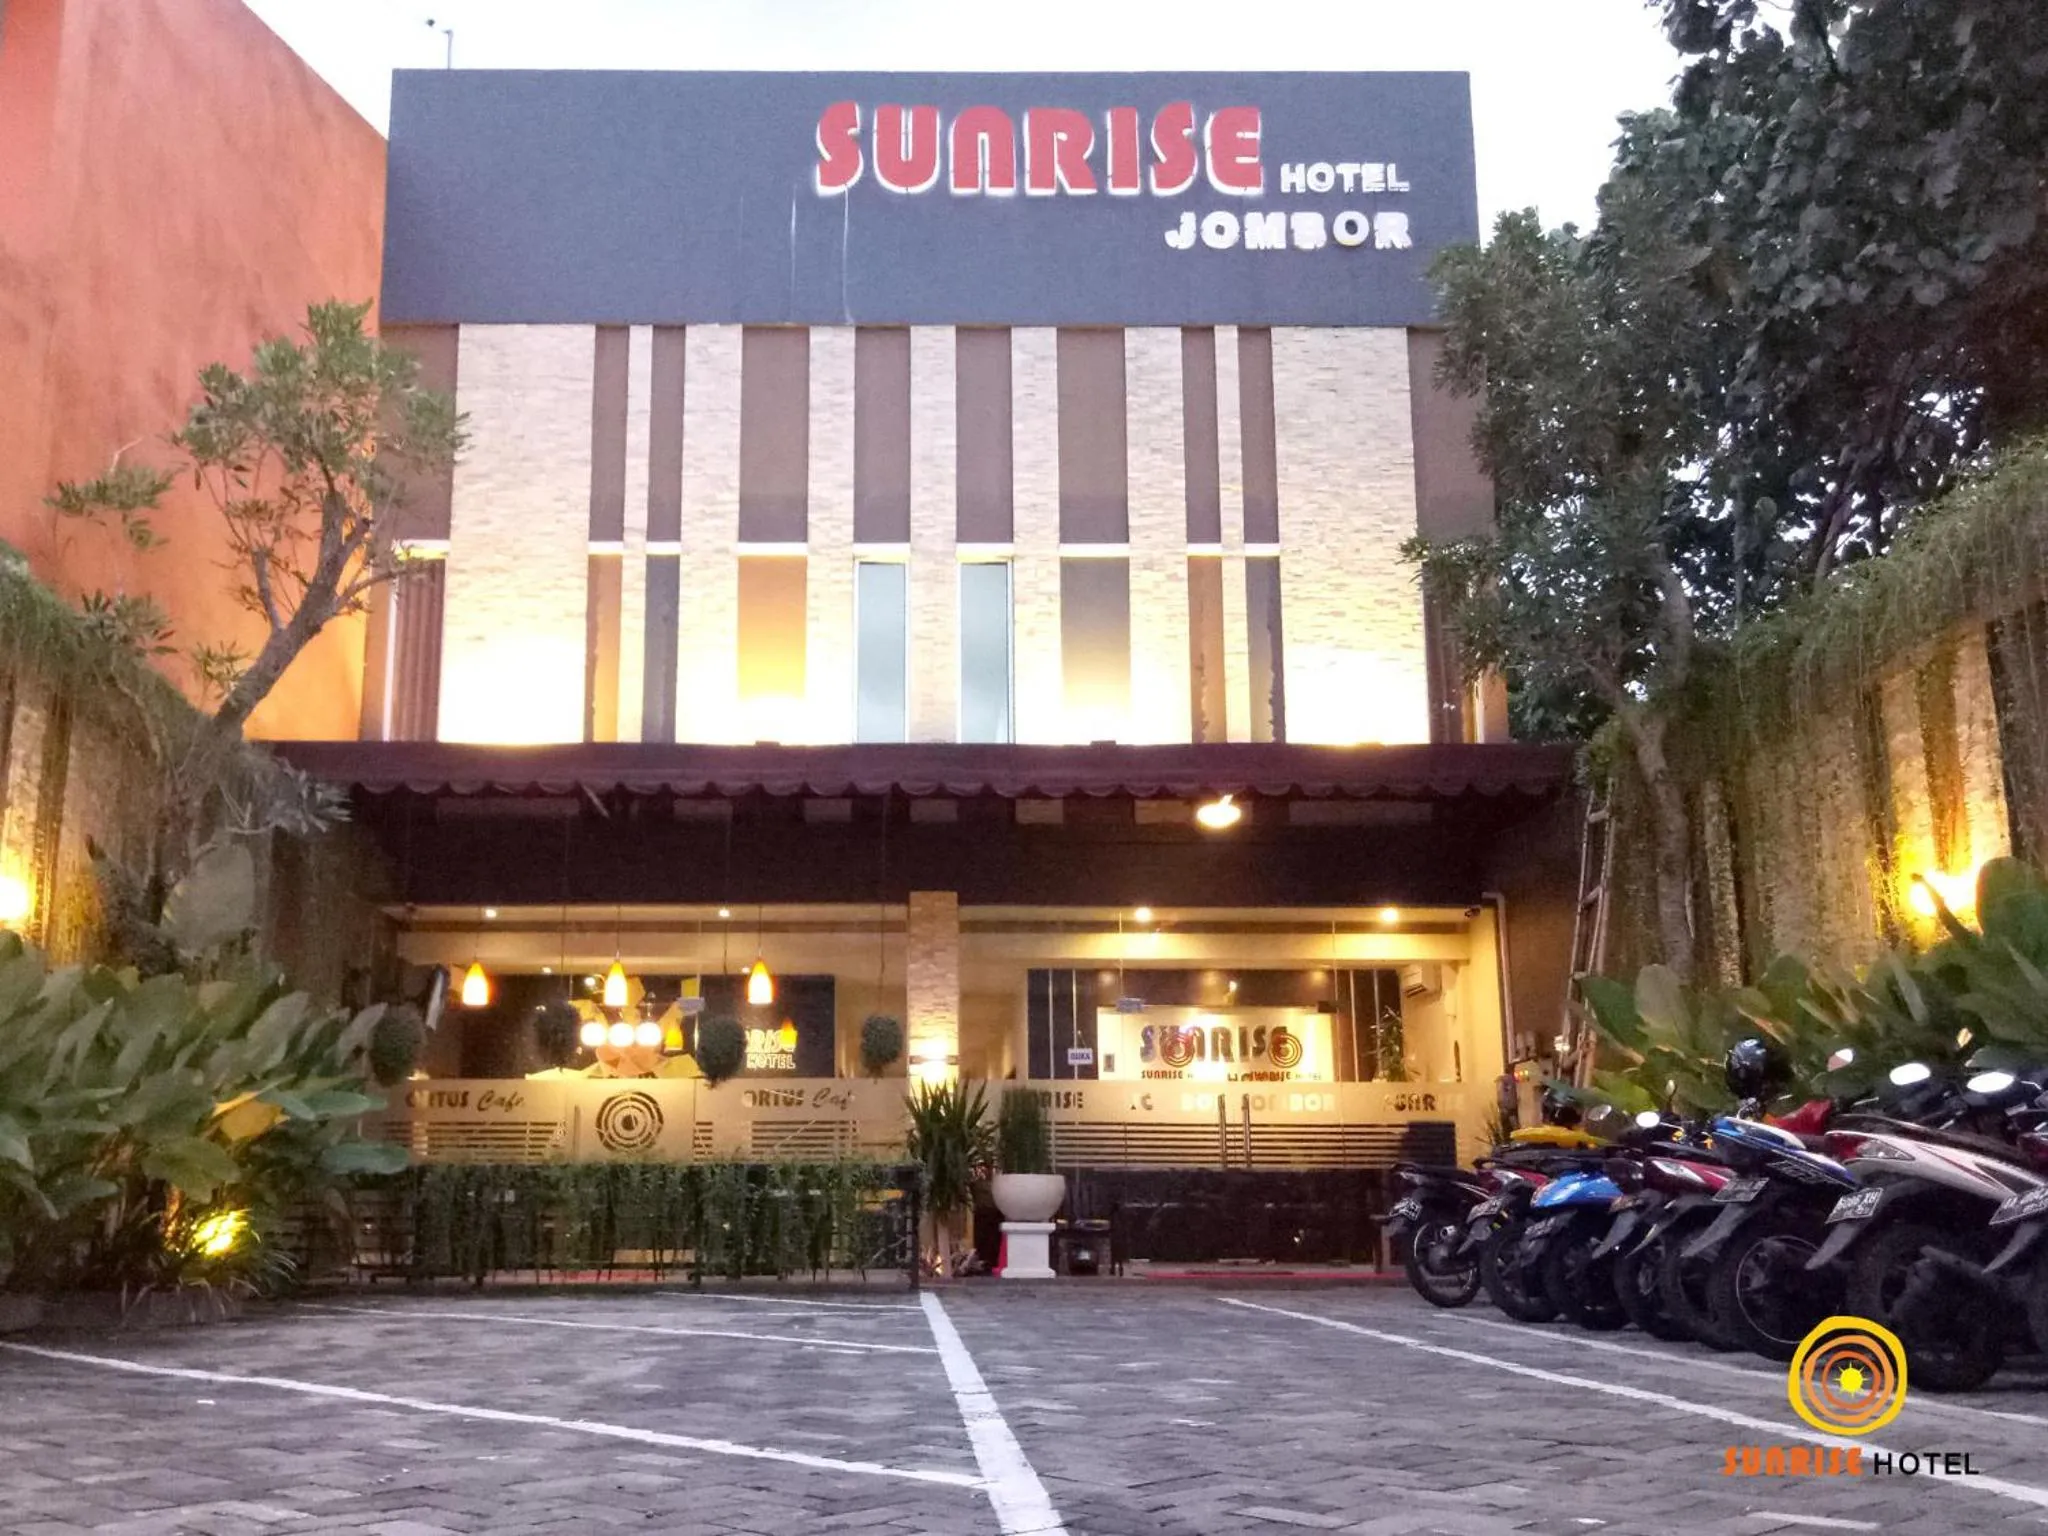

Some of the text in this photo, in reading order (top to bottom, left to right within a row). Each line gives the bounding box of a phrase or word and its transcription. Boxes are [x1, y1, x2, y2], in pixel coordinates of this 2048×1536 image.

[815, 101, 1411, 197] SUNRISE HOTEL
[1163, 210, 1413, 251] JOMBOR
